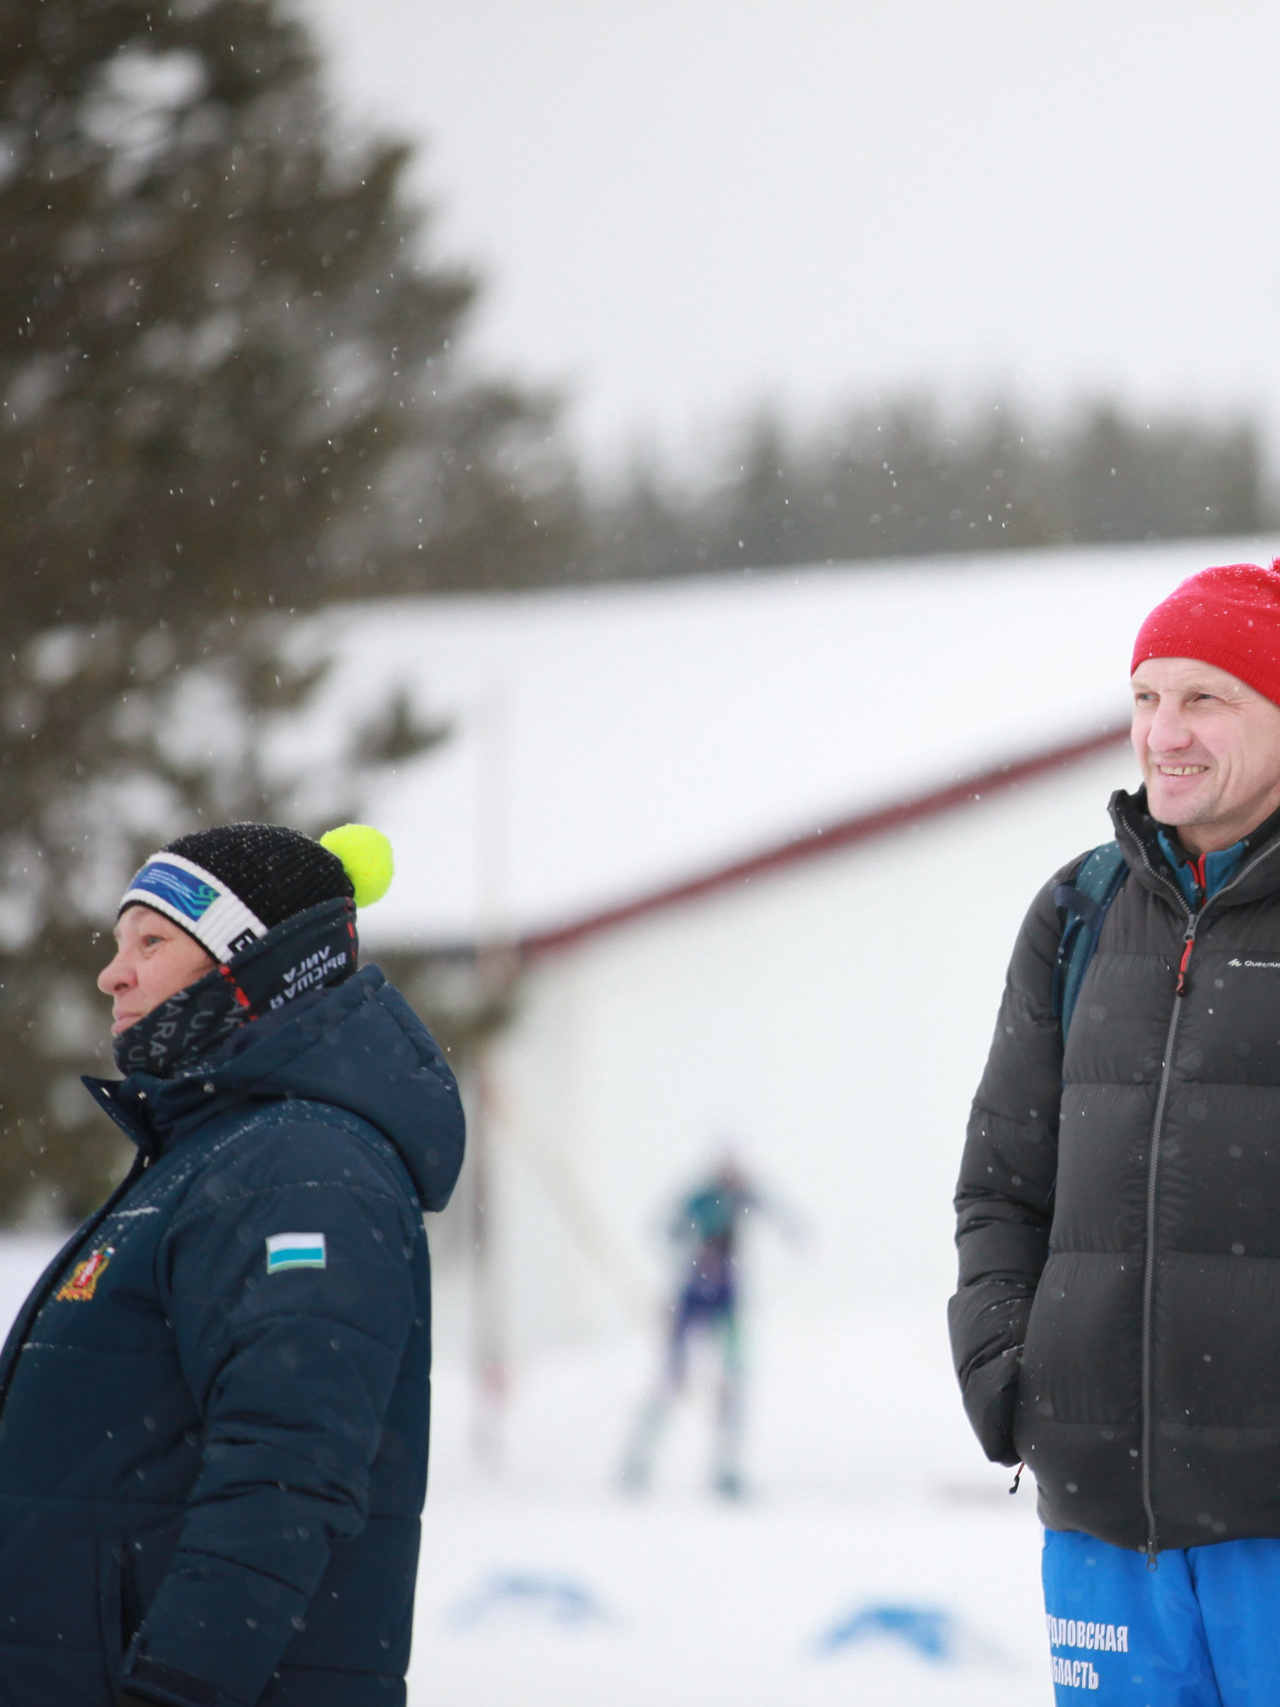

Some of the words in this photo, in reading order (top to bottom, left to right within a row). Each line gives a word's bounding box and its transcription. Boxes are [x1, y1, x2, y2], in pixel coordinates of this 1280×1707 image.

[269, 951, 347, 1010] ВЫСШАЯ
[282, 945, 331, 983] ЛИГА
[1050, 1656, 1099, 1690] БЛАСТЬ
